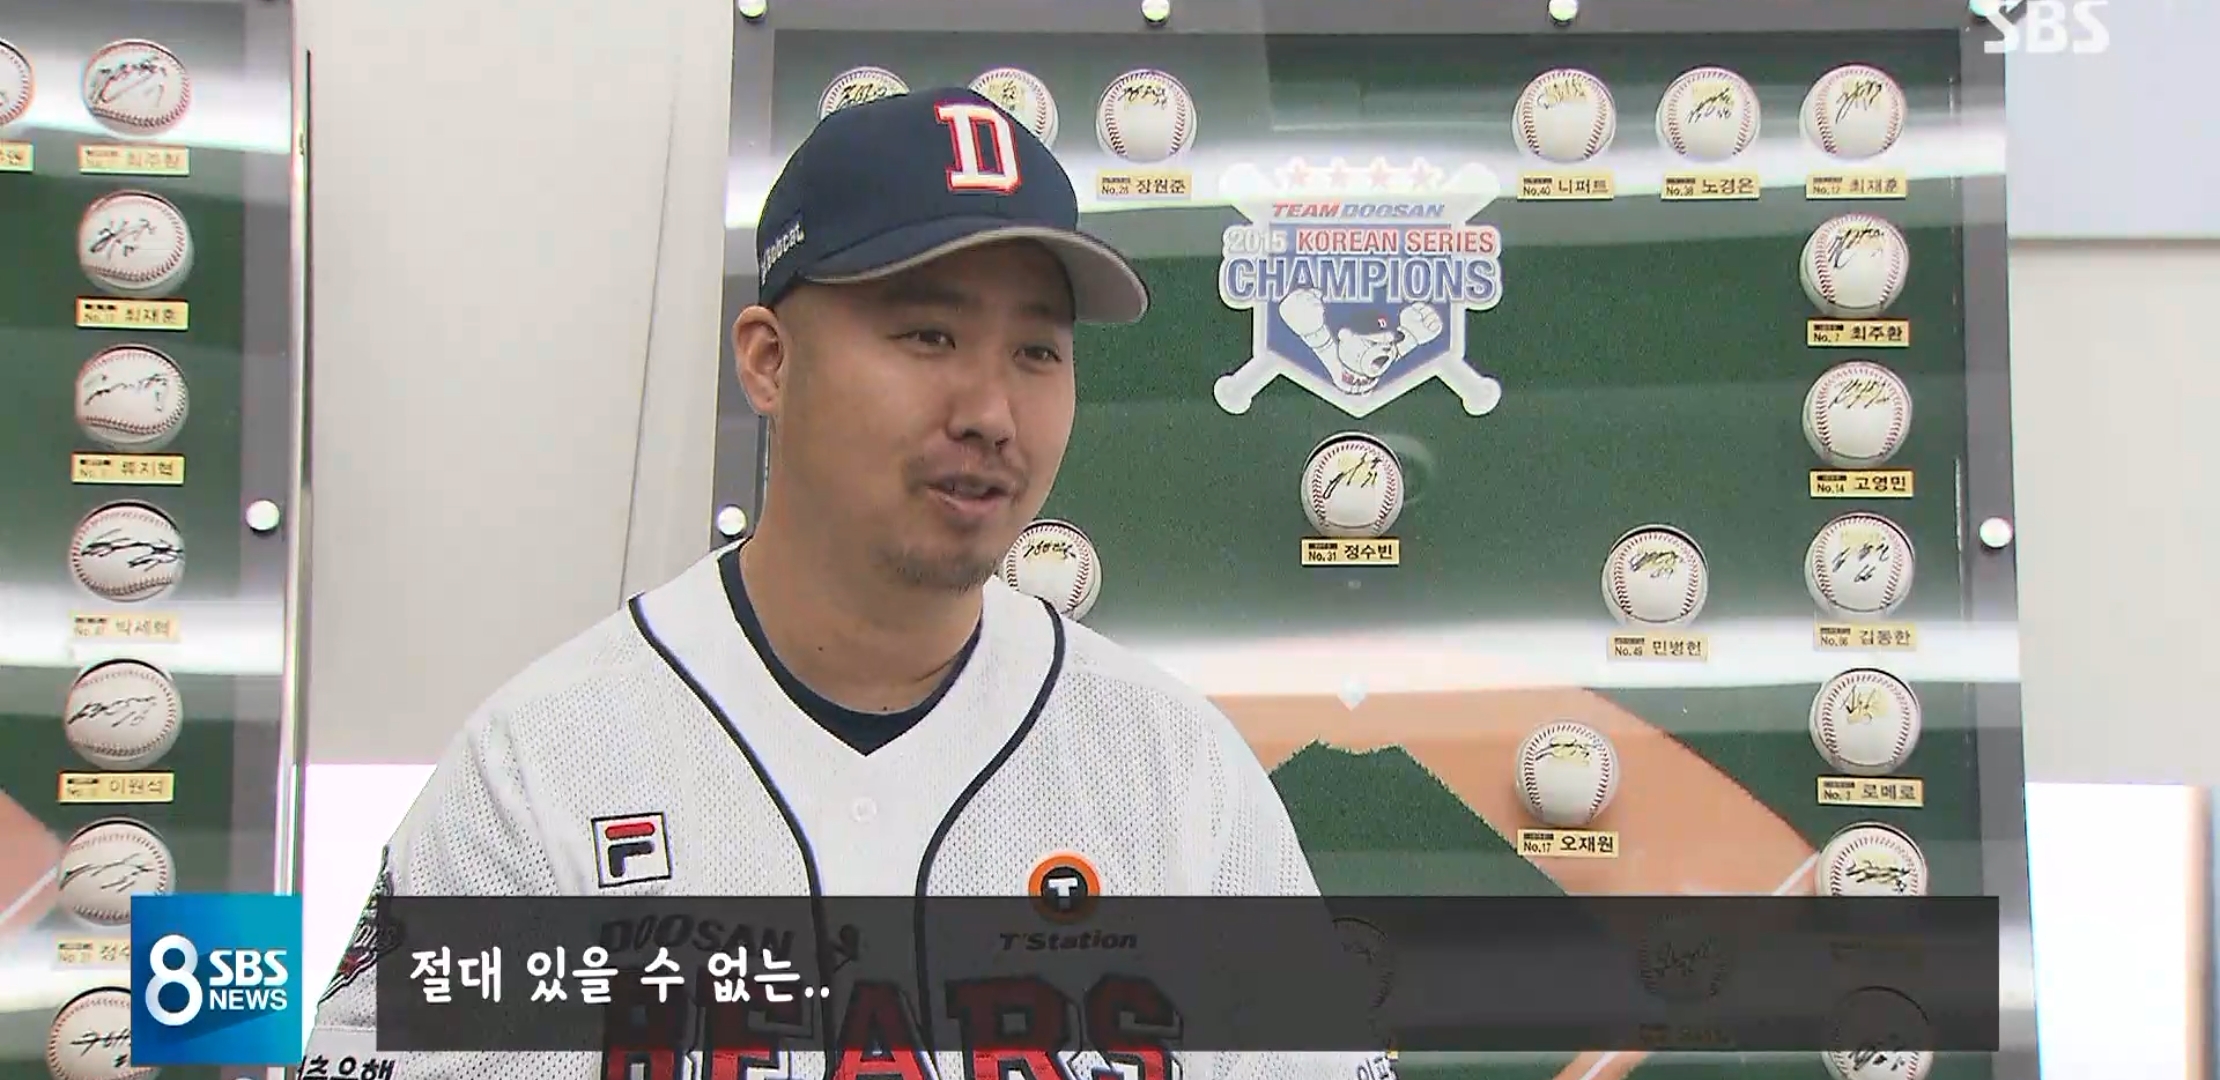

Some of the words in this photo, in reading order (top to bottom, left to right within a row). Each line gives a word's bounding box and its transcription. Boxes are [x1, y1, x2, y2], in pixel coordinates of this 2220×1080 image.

[934, 100, 1022, 194] D
[1136, 178, 1186, 194] 장원준
[1559, 179, 1608, 194] 니퍼트
[1702, 178, 1753, 194] 노경은
[1272, 203, 1339, 217] TEAM
[1340, 204, 1444, 217] DOOSAN
[1227, 230, 1287, 254] 2015
[1299, 231, 1397, 252] KOREAN
[1405, 231, 1494, 253] SERIES
[1227, 257, 1493, 300] CHAMPIONS
[1855, 476, 1906, 491] 고영민
[1344, 544, 1392, 560] 정수빈
[1652, 640, 1702, 656] 민병헌
[1560, 836, 1613, 853] 오재원
[1045, 875, 1079, 910] T
